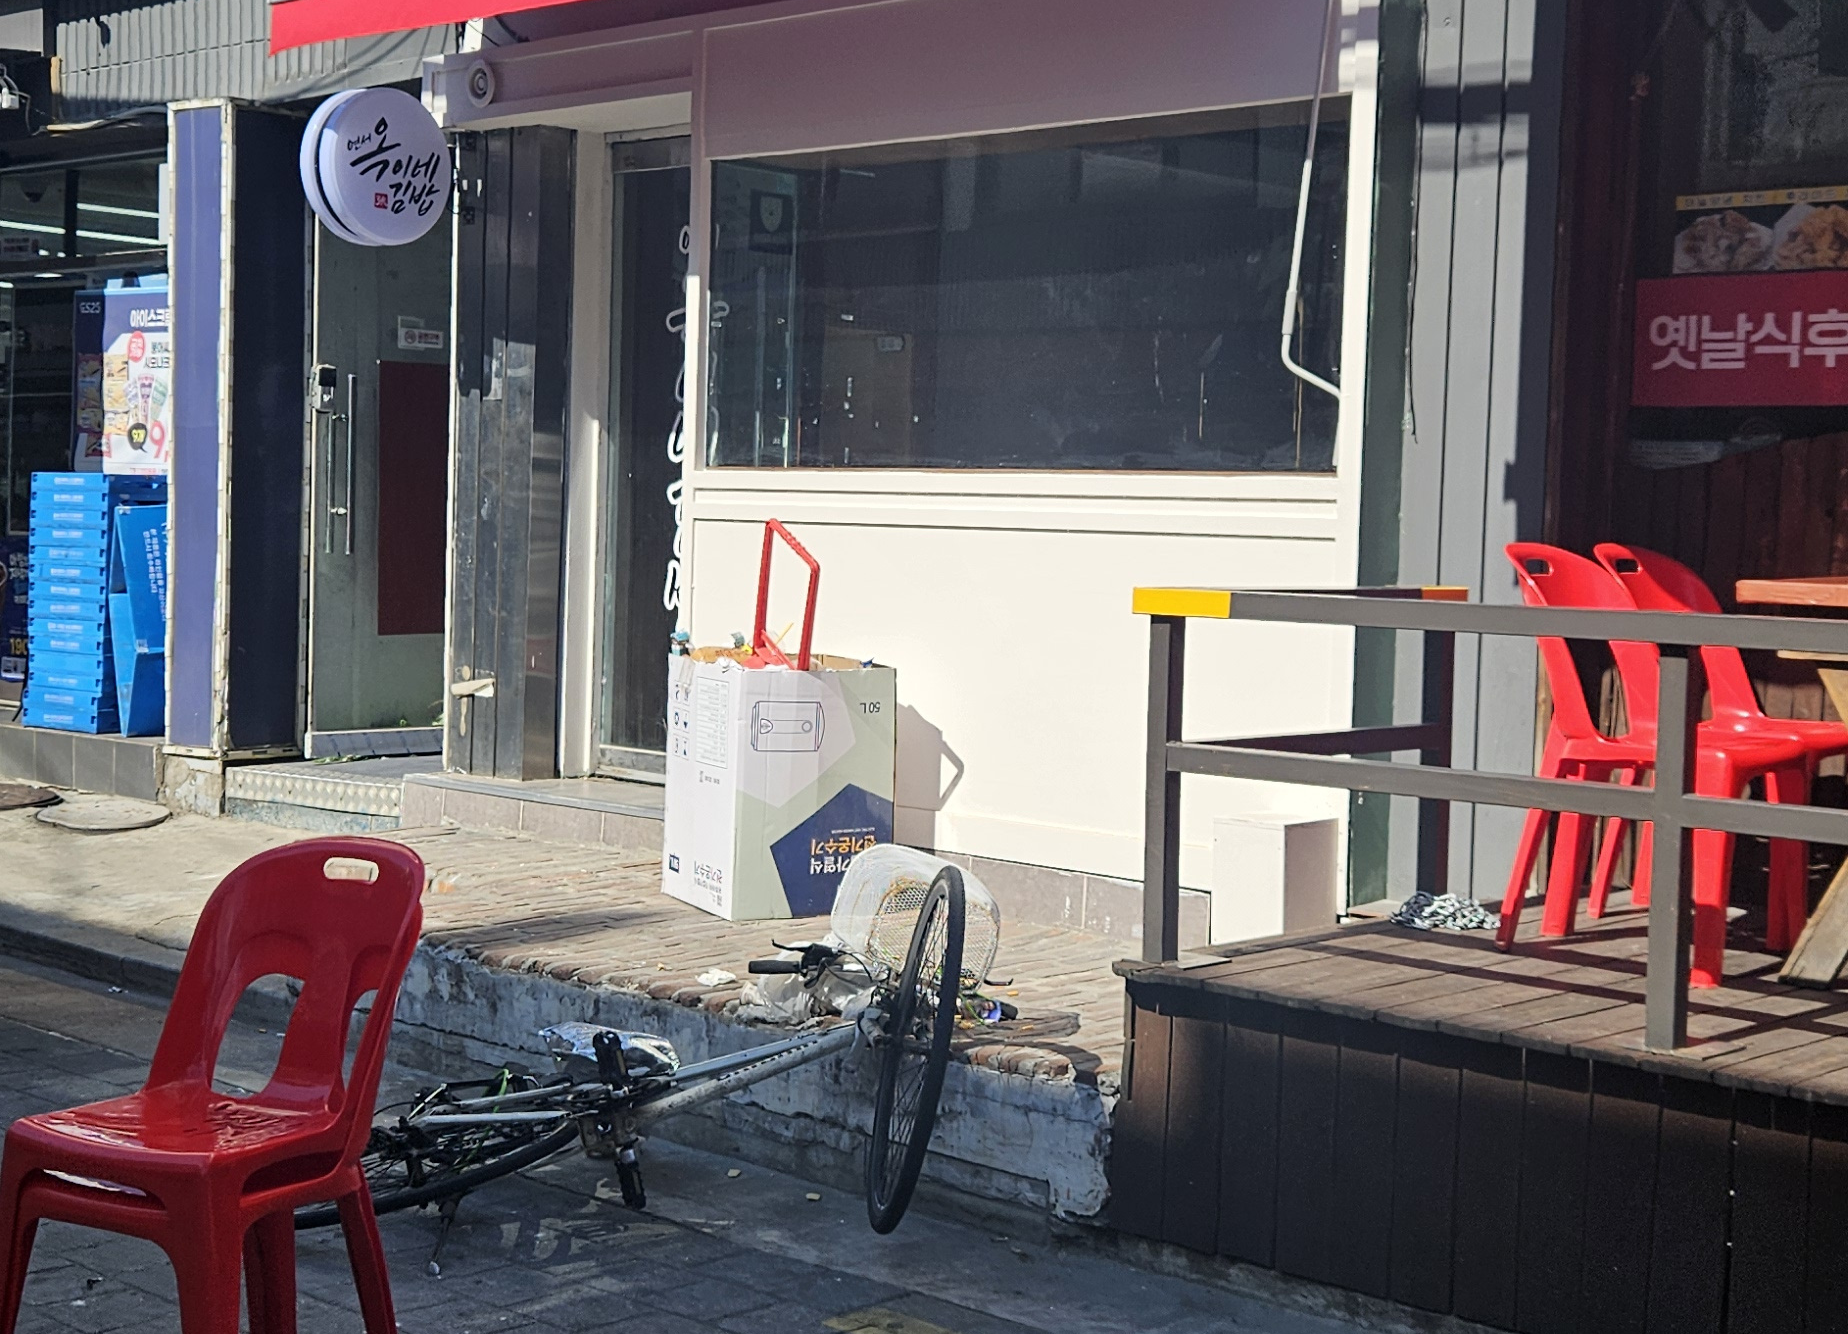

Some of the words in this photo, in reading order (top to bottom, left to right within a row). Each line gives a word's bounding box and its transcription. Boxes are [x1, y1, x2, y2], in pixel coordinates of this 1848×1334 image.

[350, 117, 441, 184] 옥이네
[389, 180, 441, 217] 김밥
[811, 835, 877, 856] 전기온수기
